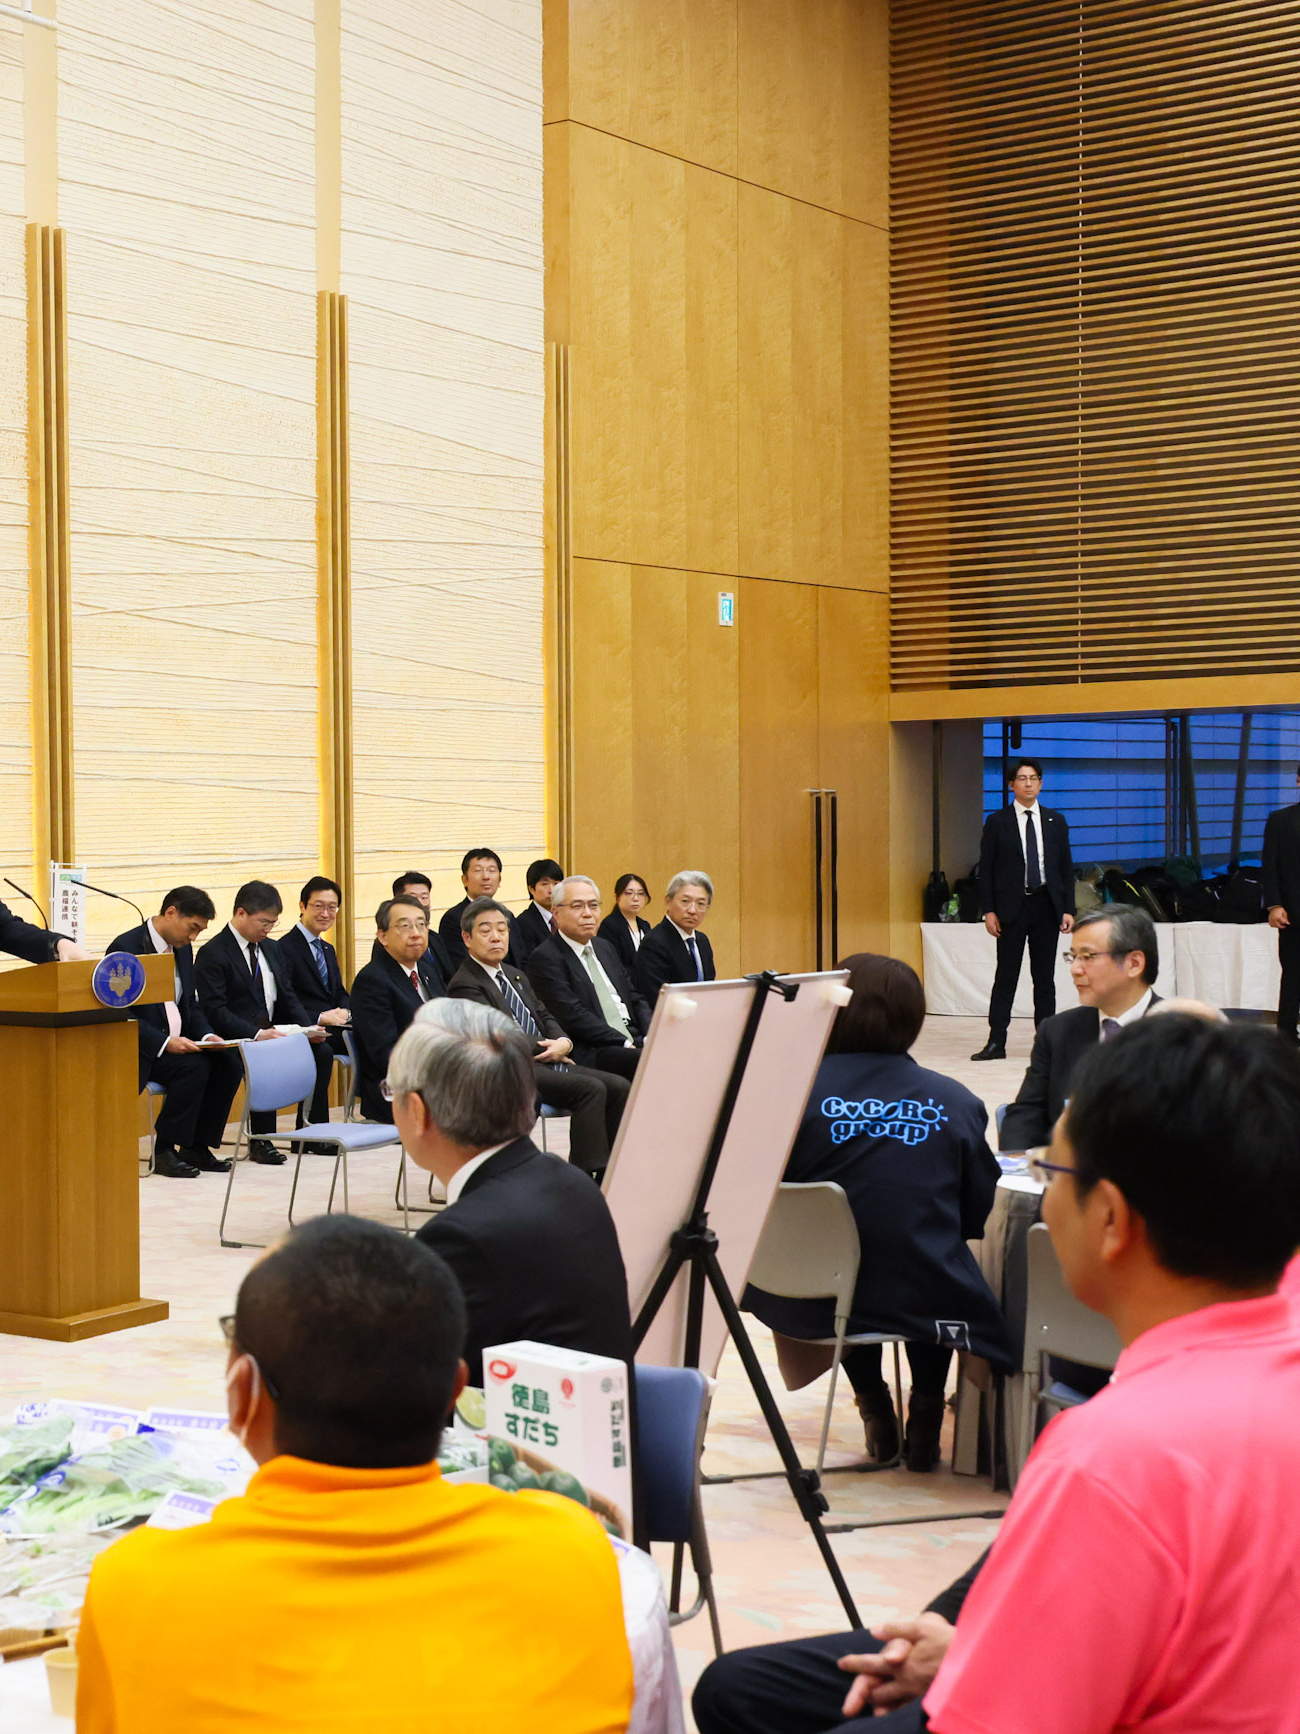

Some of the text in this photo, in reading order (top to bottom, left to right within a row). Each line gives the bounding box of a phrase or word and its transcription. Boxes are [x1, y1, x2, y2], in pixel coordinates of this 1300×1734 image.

[831, 1120, 929, 1145] group
[512, 1383, 550, 1414] 徳島
[504, 1412, 559, 1447] すだち
